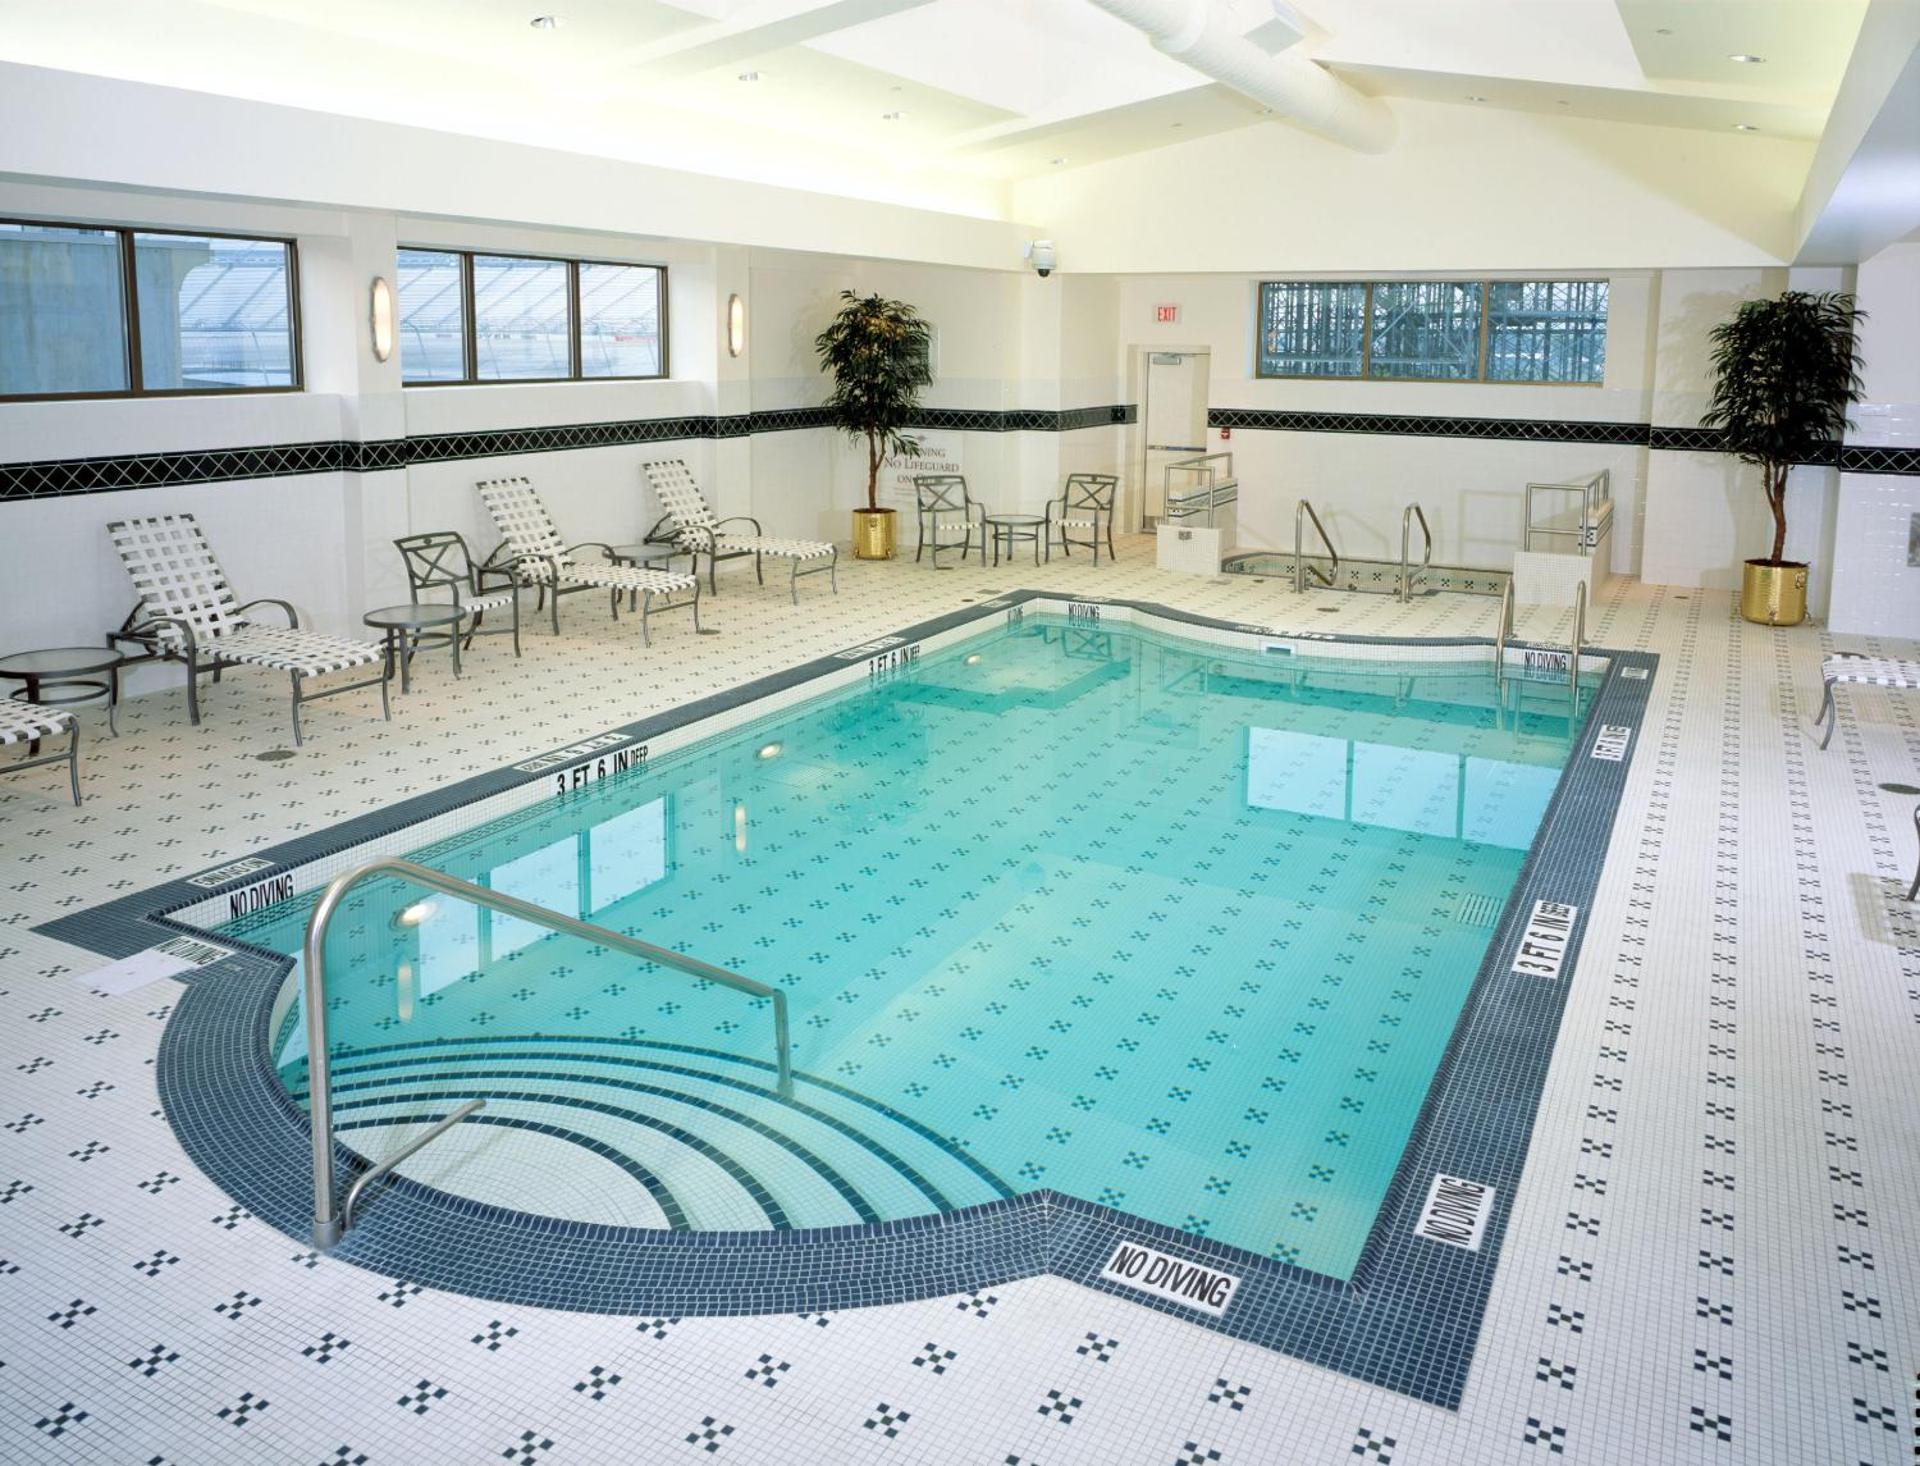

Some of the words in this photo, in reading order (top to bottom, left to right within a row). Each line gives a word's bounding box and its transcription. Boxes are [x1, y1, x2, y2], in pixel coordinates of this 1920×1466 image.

[1158, 307, 1177, 322] EXIT
[904, 458, 960, 472] LIFEGUARD
[1524, 652, 1535, 668] NO
[1537, 653, 1567, 671] DIVING
[557, 774, 566, 796] 3
[573, 764, 590, 789] FT
[598, 759, 606, 779] 6
[614, 749, 628, 774] IN
[230, 888, 247, 920] NO
[250, 874, 294, 911] DIVING
[1531, 914, 1570, 931] IN
[1528, 931, 1565, 942] 6
[1521, 942, 1561, 961] FT
[1517, 961, 1555, 972] 3
[1430, 1178, 1486, 1227] DIVING
[1423, 1220, 1473, 1246] NO
[1109, 1246, 1149, 1278] NO
[1142, 1256, 1231, 1308] DIVING
